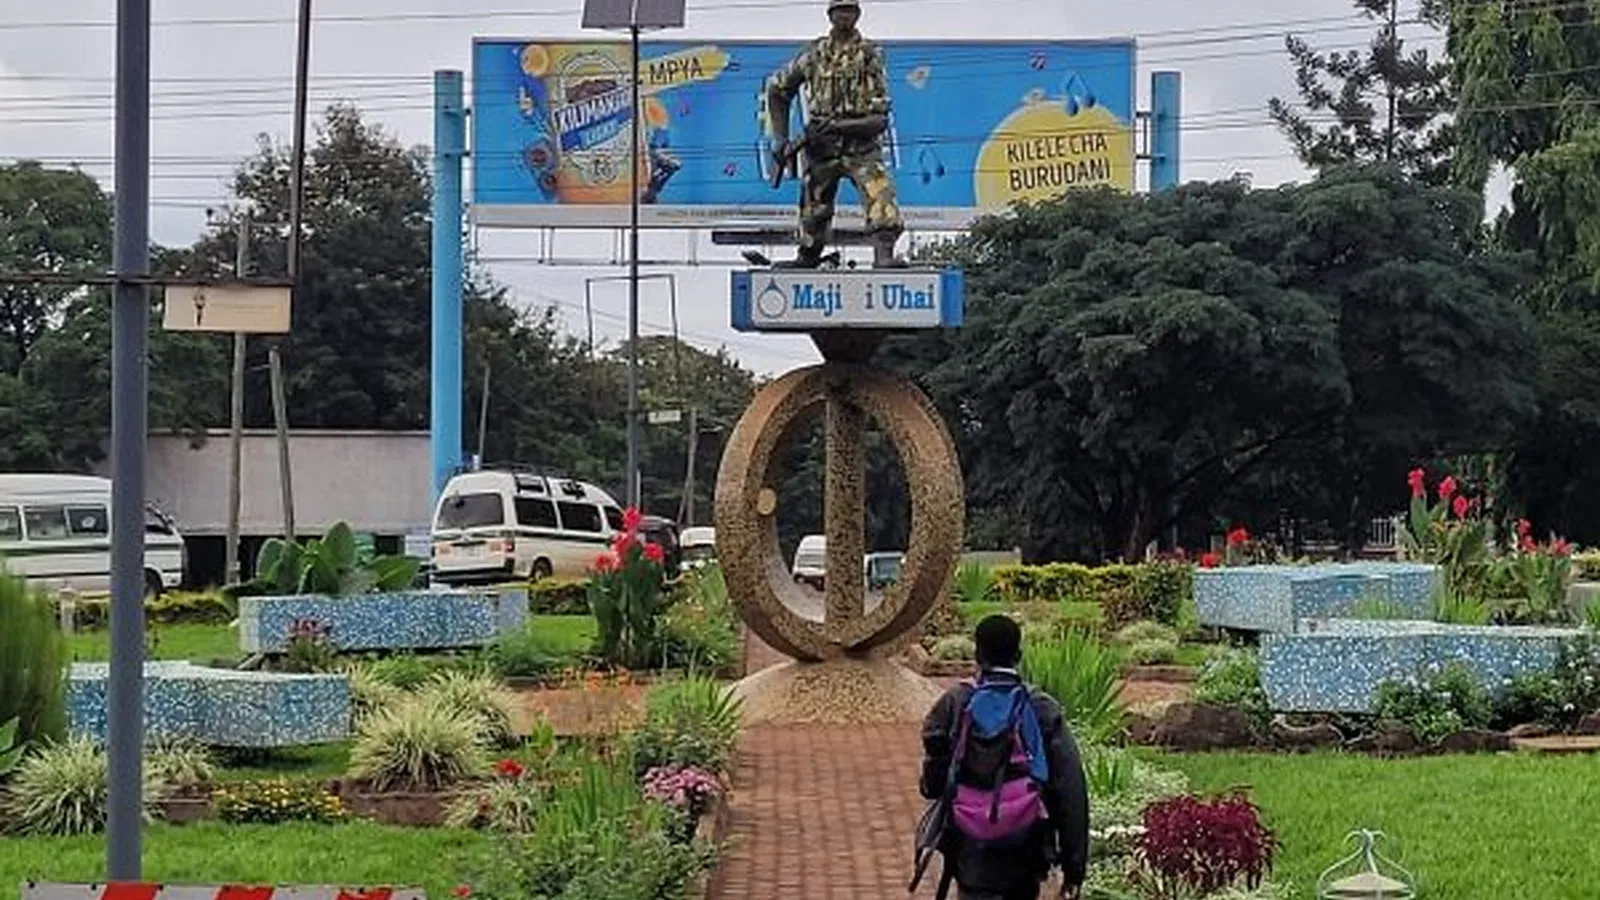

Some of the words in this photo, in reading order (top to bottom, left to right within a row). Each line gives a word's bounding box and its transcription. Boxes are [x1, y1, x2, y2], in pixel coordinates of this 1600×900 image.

[649, 57, 704, 84] MPYA
[1007, 136, 1066, 162] KILELE
[1069, 133, 1108, 155] CHA
[1010, 158, 1110, 191] BURUDANI
[791, 284, 843, 316] Maji
[881, 284, 935, 309] Uhai
